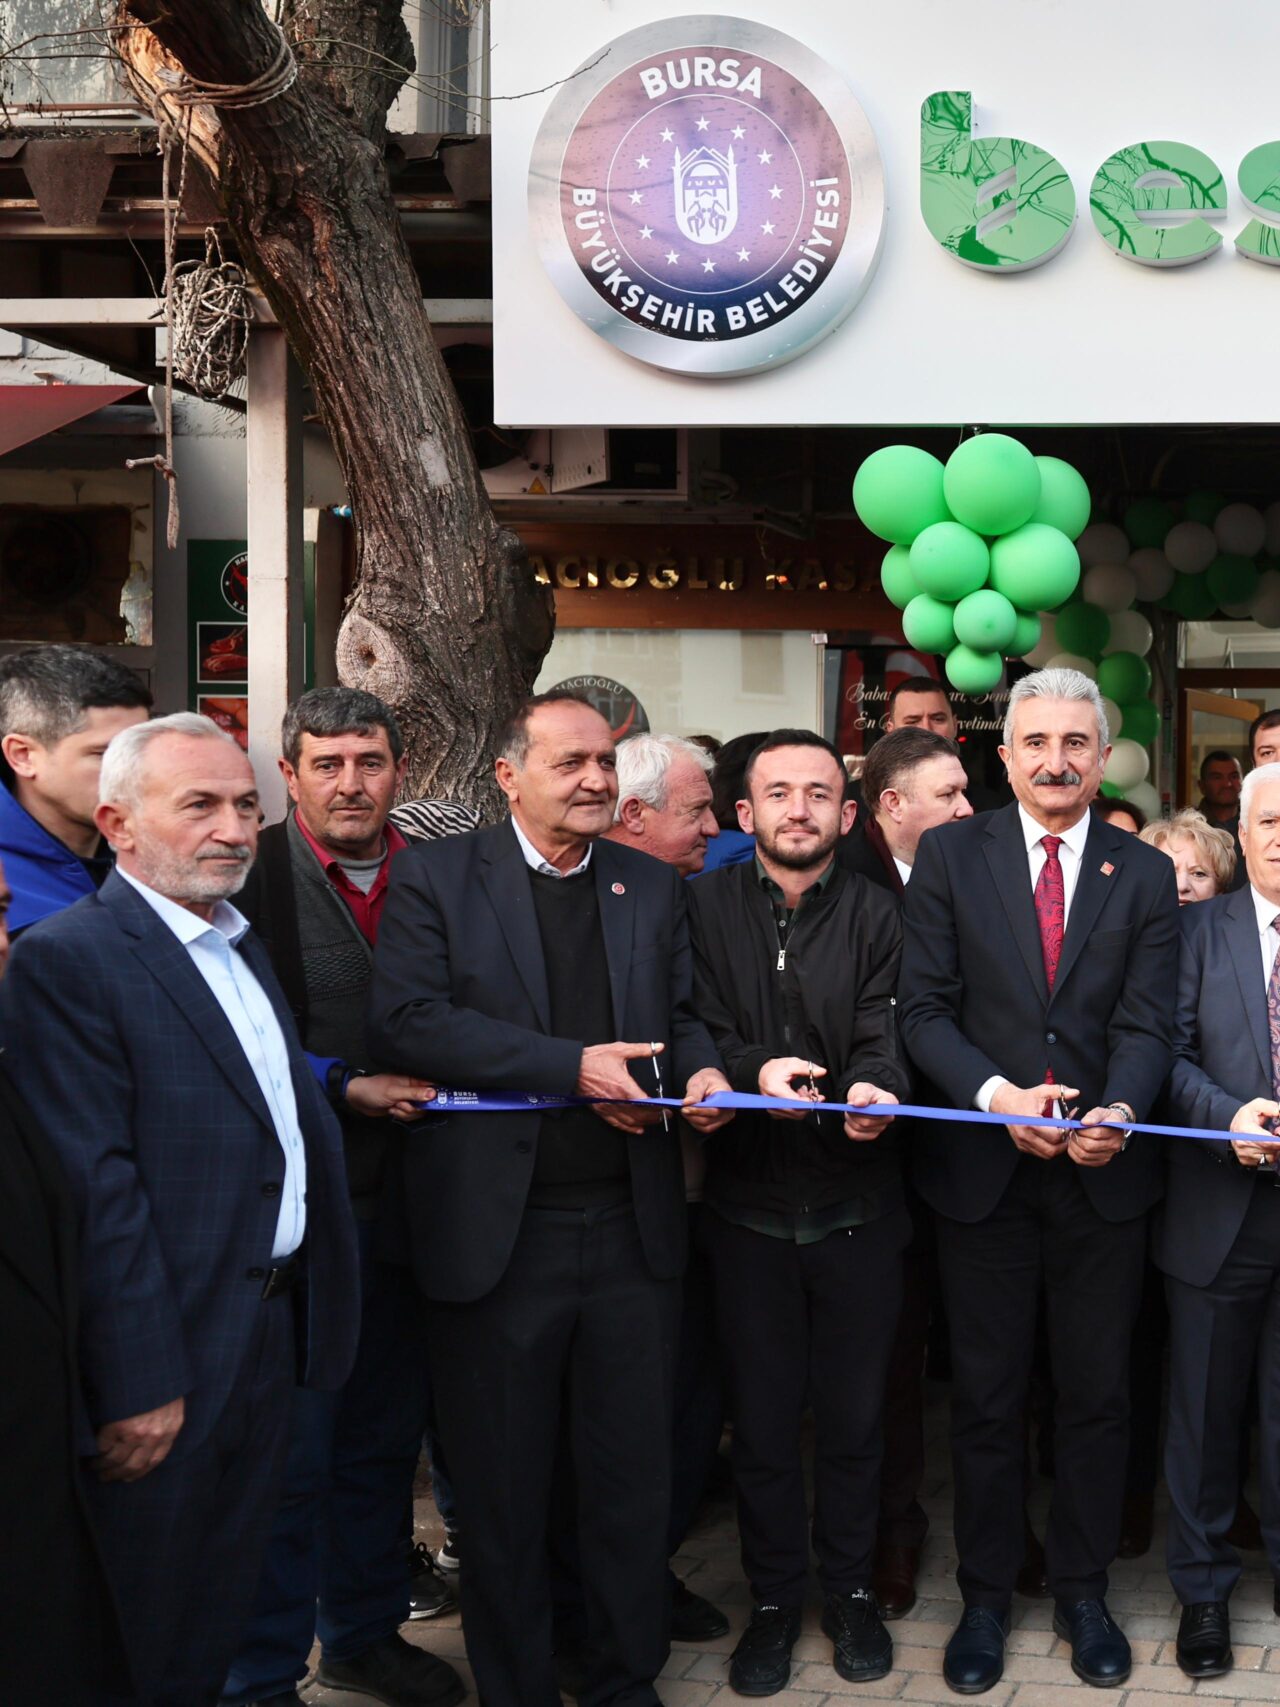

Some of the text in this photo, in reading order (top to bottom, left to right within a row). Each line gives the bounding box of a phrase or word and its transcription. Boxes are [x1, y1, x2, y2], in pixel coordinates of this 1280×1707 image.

[639, 56, 762, 99] BURSA
[572, 176, 841, 334] BÜYÜKŞEHİR BELEDİYESİ
[528, 549, 745, 591] ACIOĞLU
